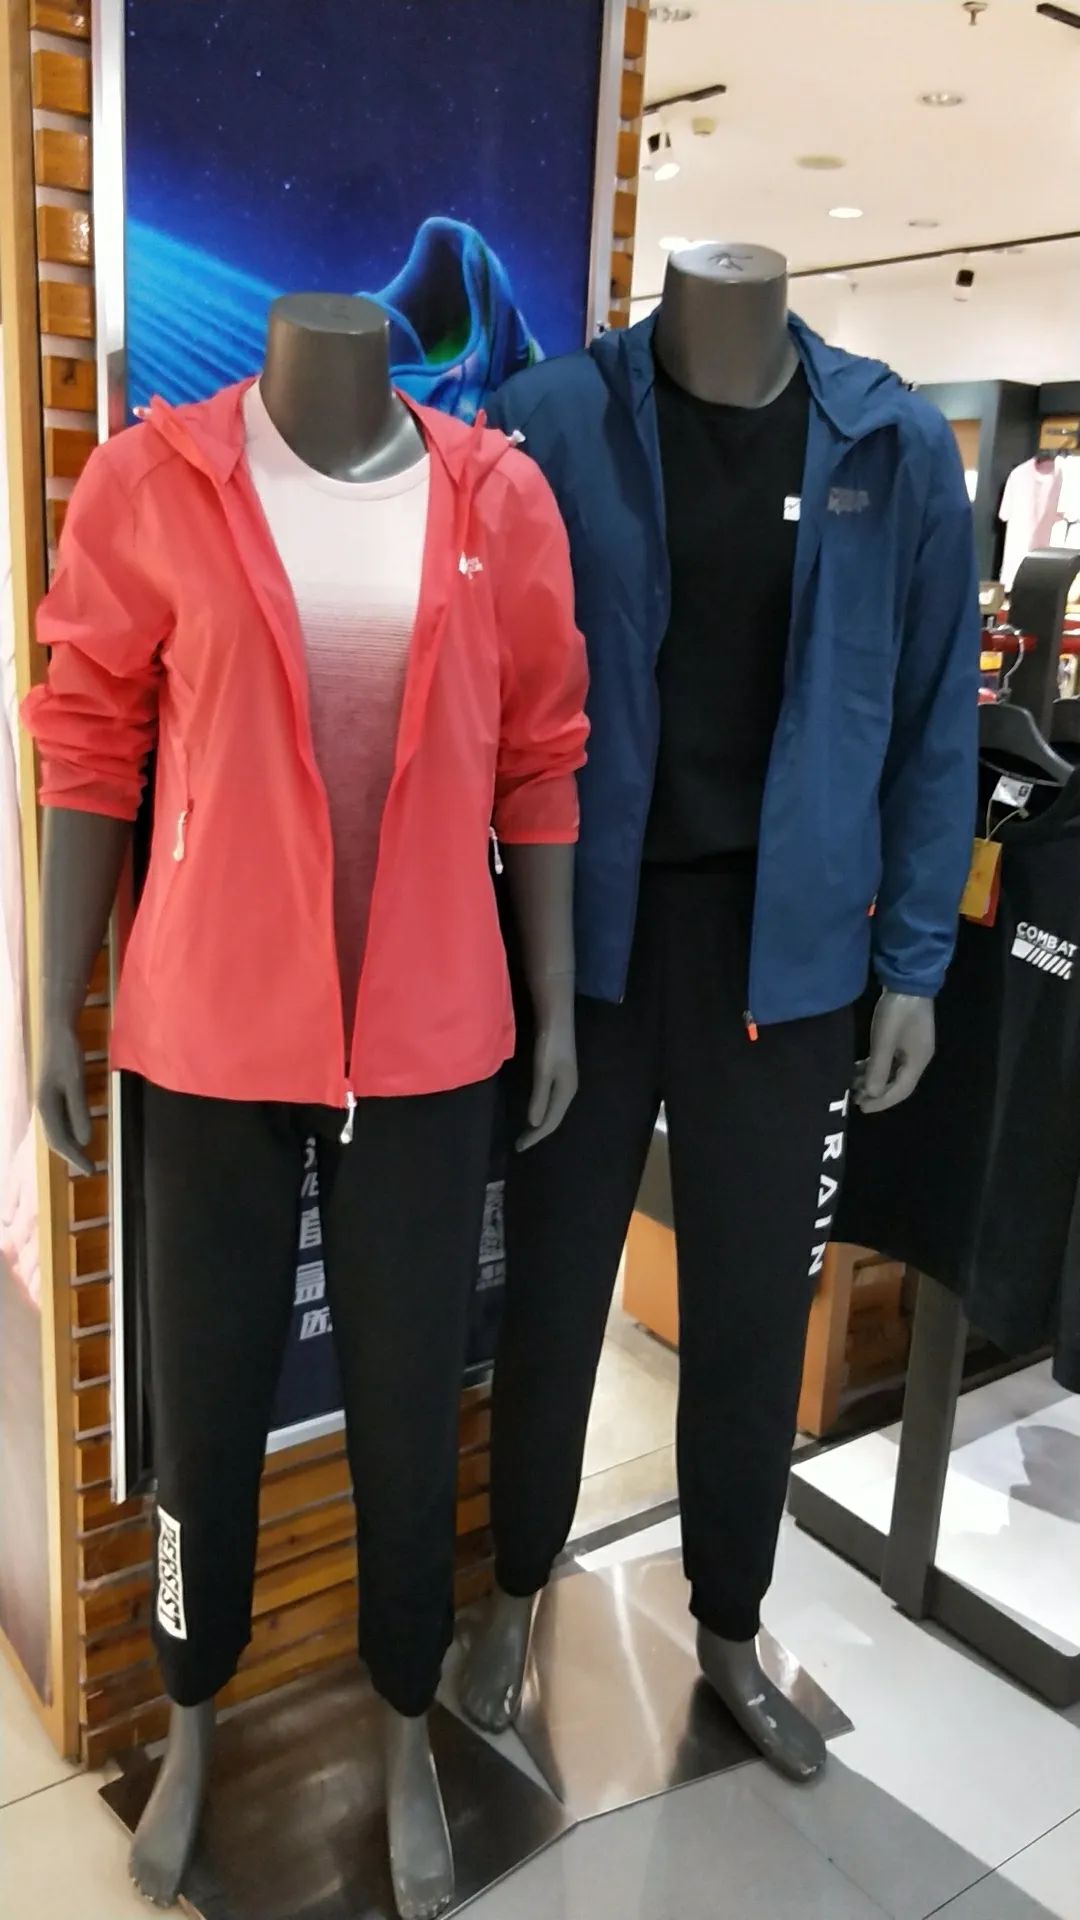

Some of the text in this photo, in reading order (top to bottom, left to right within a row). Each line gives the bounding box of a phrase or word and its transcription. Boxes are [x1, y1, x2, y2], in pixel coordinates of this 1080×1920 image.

[1016, 921, 1078, 957] COMBAT
[808, 1088, 850, 1276] TRAIN
[160, 1519, 182, 1631] PERSIST
